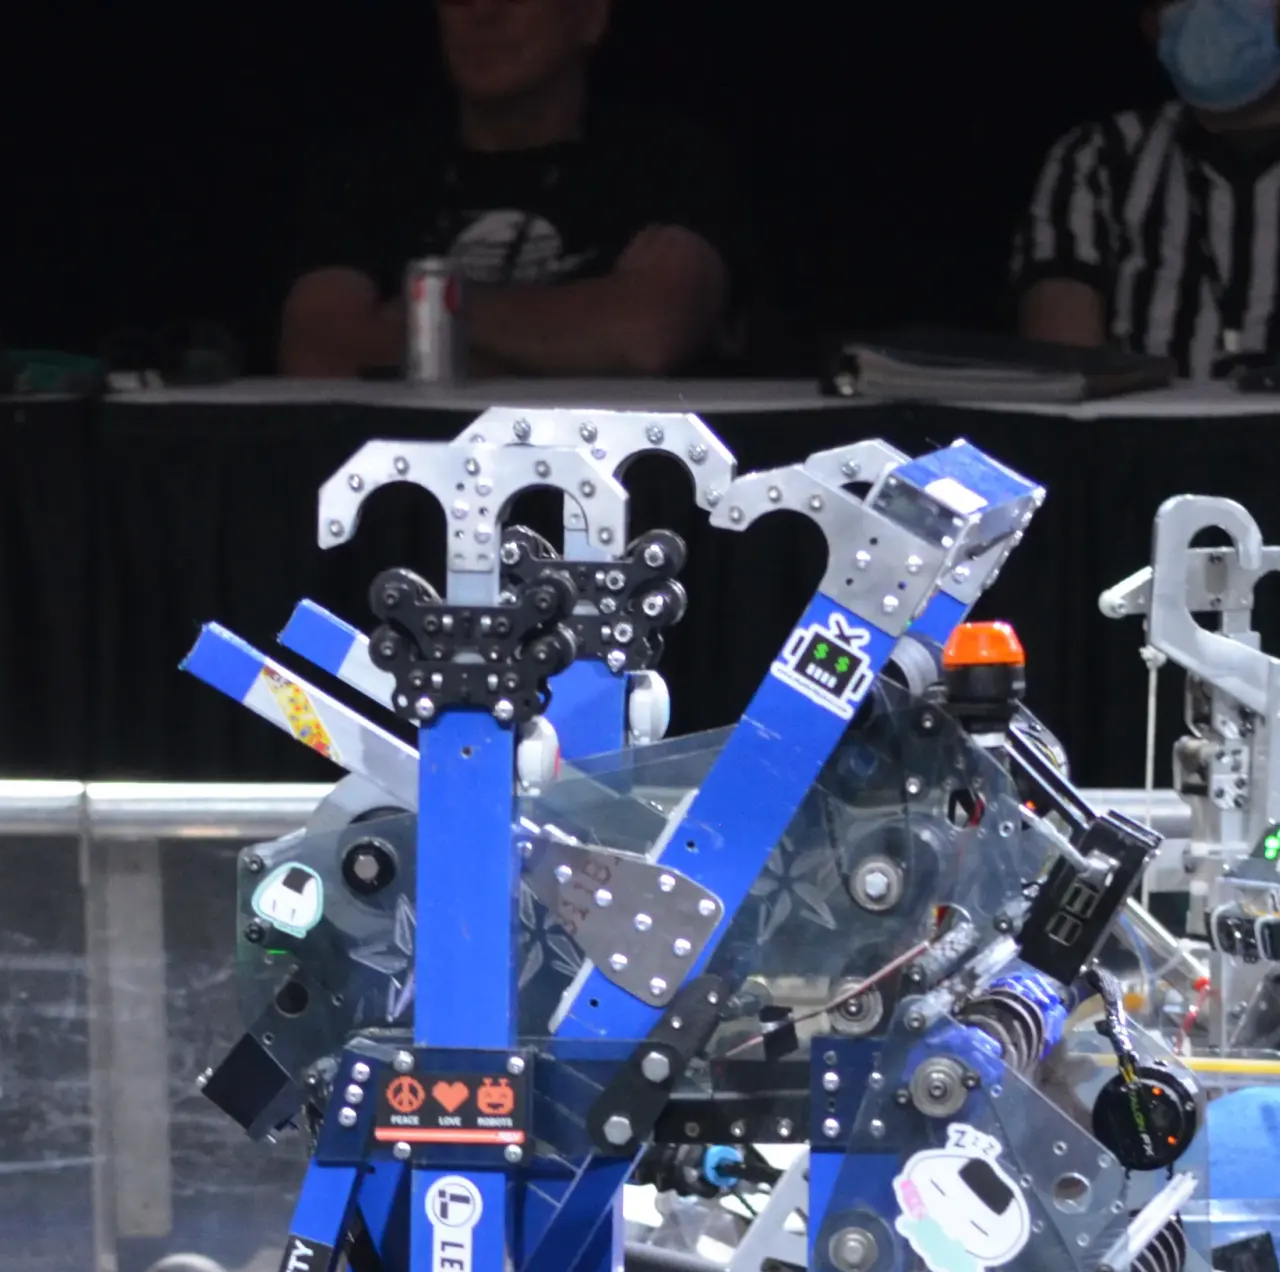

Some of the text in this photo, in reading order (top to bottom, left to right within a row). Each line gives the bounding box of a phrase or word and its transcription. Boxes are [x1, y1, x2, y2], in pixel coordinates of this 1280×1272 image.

[390, 1115, 513, 1128] PEACE LOVE ROBOTS
